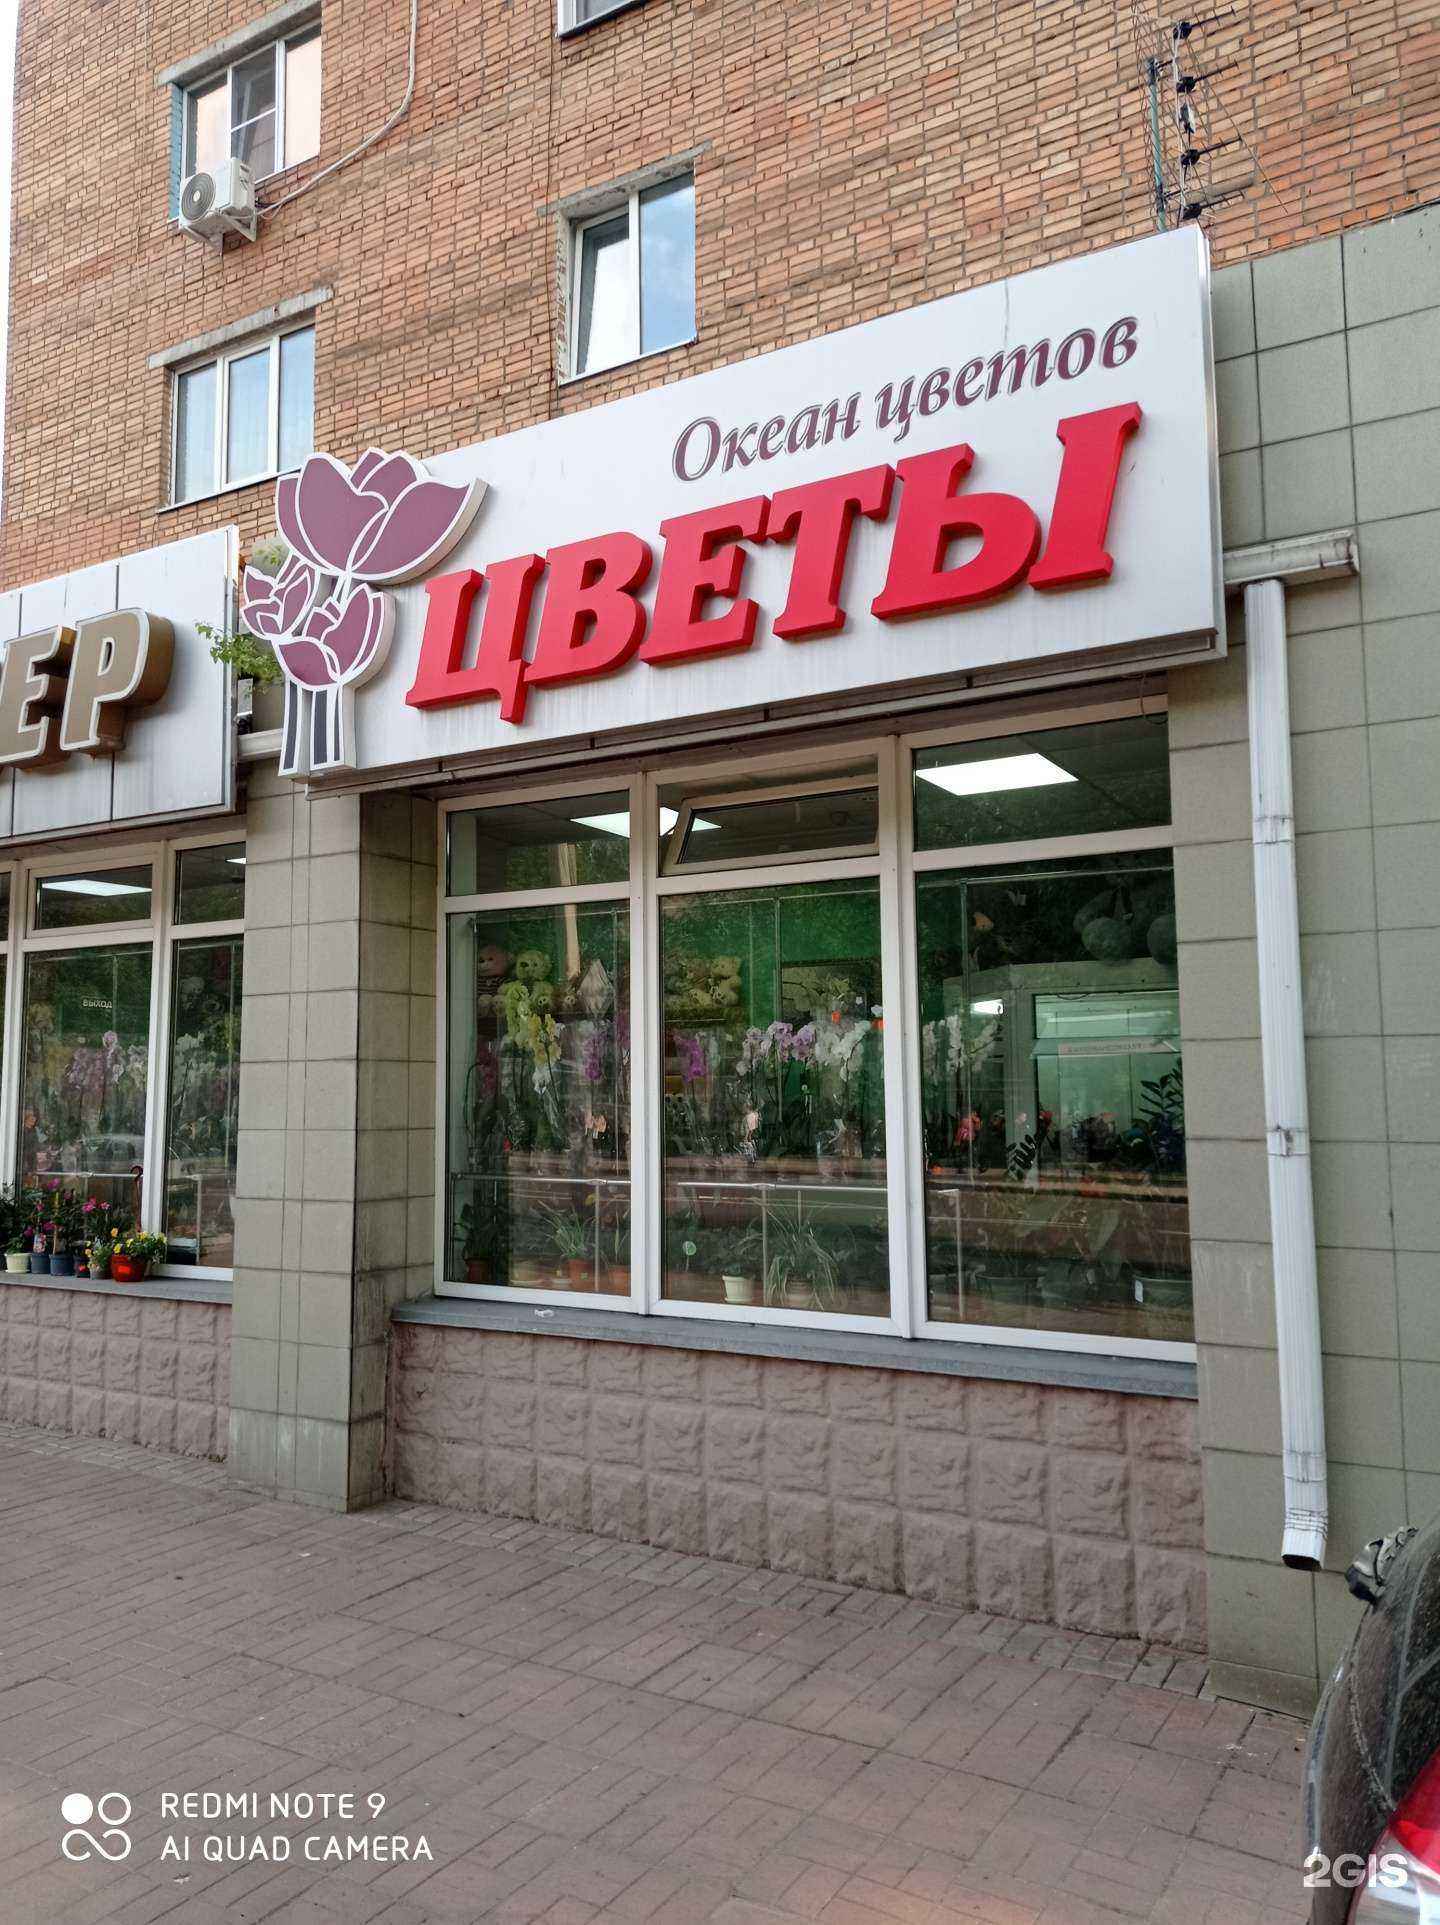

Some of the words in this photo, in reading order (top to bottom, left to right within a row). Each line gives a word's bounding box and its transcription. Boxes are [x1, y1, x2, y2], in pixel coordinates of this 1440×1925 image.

[672, 390, 863, 482] Океан
[874, 315, 1139, 445] цветов
[405, 401, 1143, 724] ЦВЕТЫ
